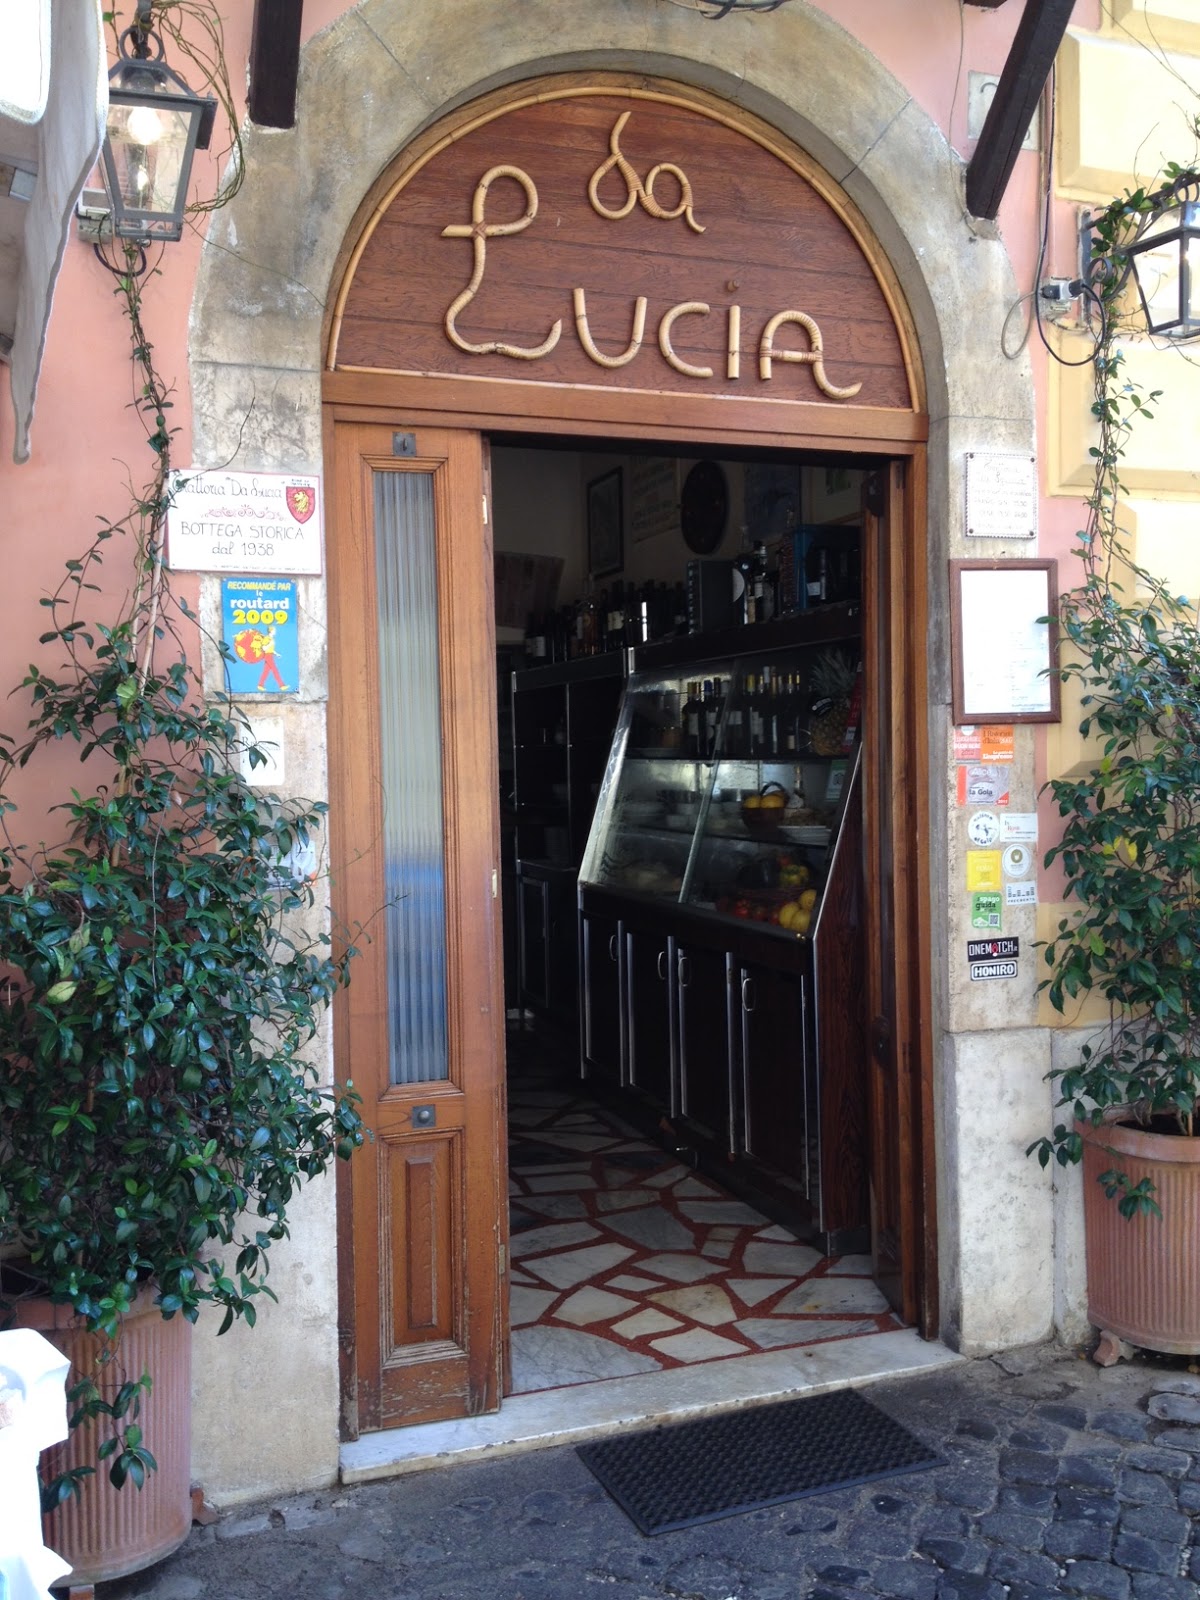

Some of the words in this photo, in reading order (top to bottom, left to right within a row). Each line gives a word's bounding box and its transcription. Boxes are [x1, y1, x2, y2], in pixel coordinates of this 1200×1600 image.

[589, 111, 706, 233] da
[226, 477, 248, 497] Da
[181, 521, 243, 539] BOTTEGA
[249, 526, 304, 541] STORICA
[212, 542, 234, 556] dal
[241, 542, 275, 557] 1938
[227, 581, 277, 591] RECOMMANDÉ
[277, 583, 291, 592] PAR
[230, 597, 290, 610] routard
[232, 609, 289, 625] 2009
[974, 964, 1014, 977] HONIRO
